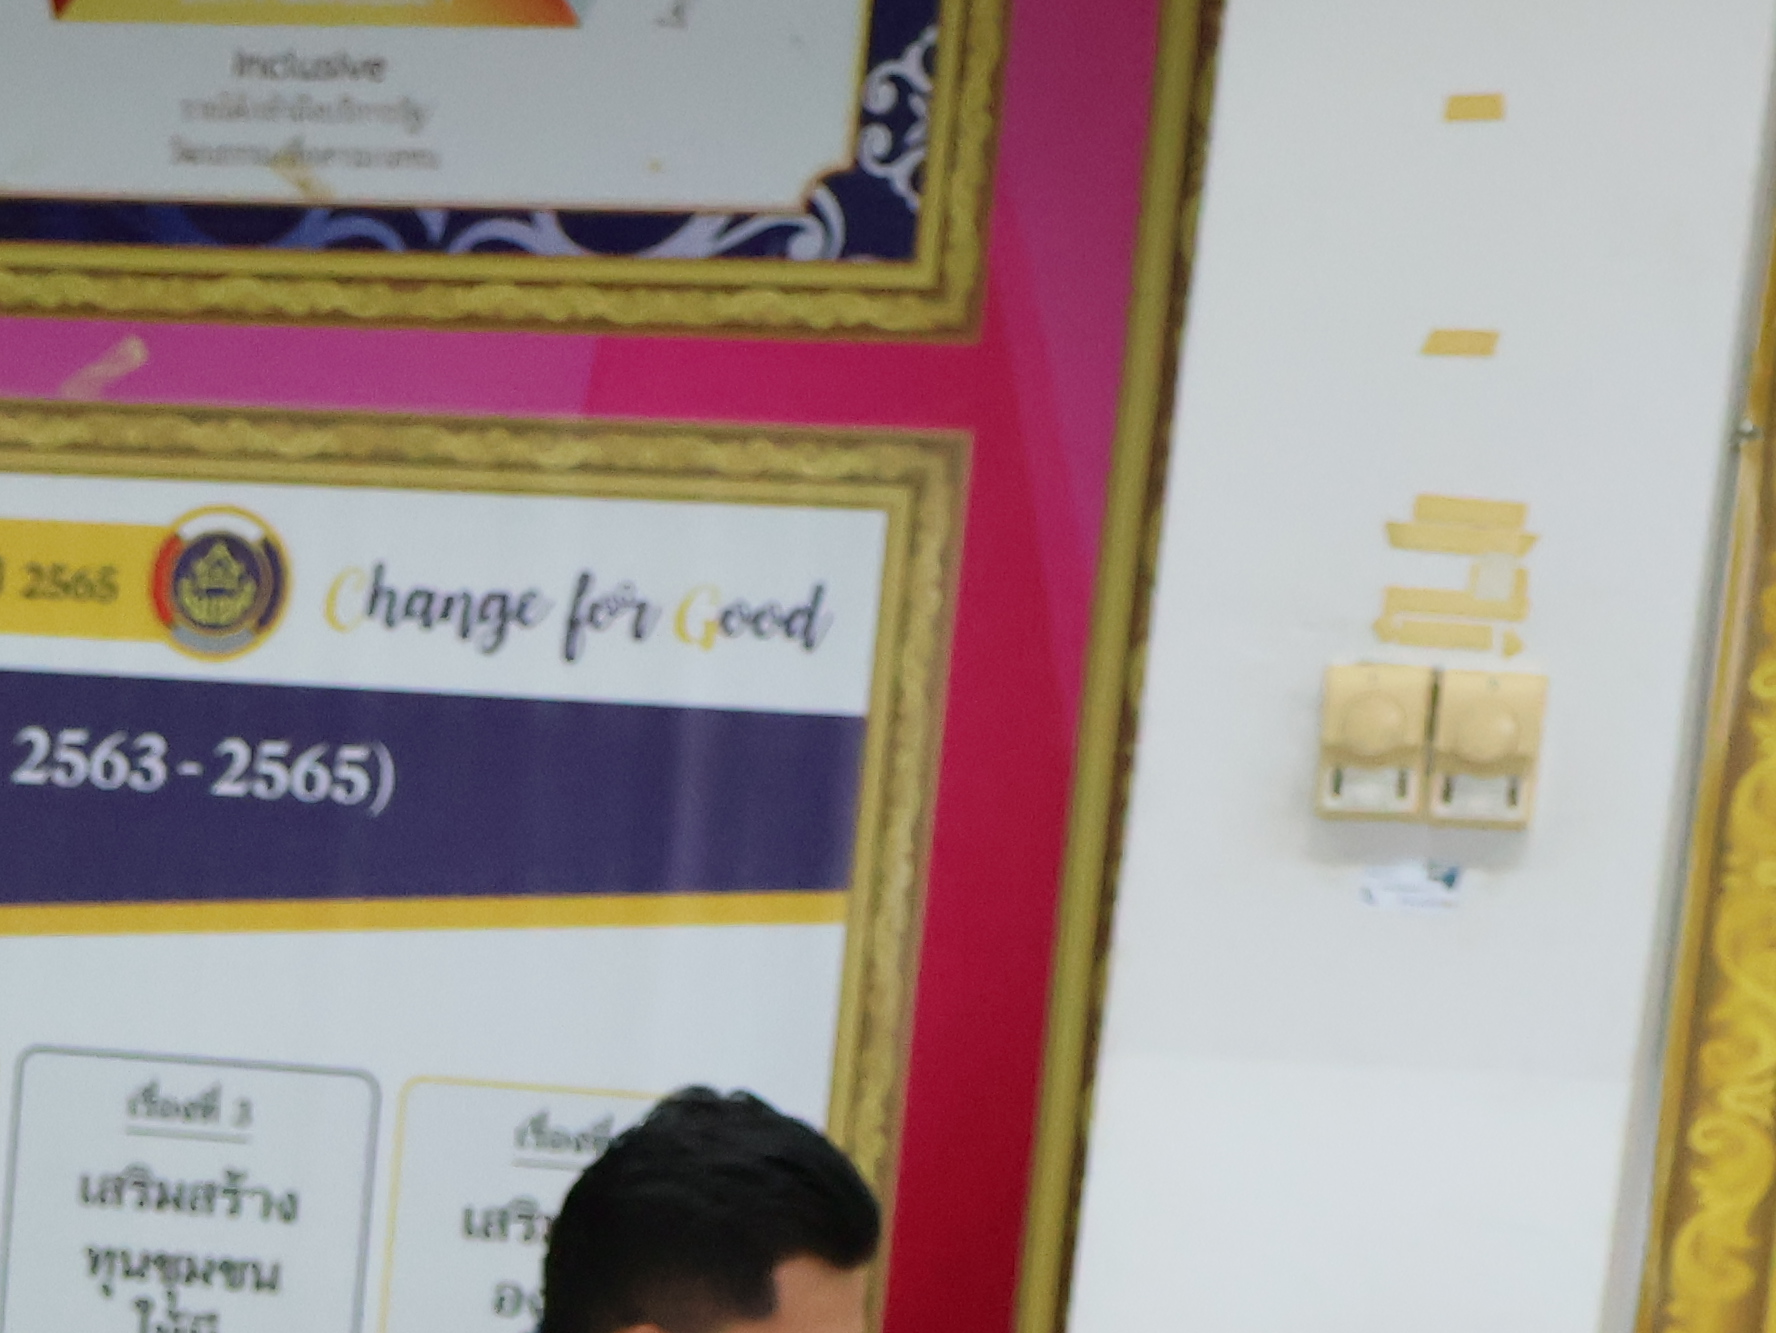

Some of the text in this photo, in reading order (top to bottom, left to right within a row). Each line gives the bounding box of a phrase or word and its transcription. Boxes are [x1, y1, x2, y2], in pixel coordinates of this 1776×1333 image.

[232, 50, 388, 82] Inclusive
[20, 561, 118, 602] 2565
[324, 562, 826, 662] Change for Good
[79, 1163, 299, 1225] เสริมสร้าง
[85, 1246, 280, 1302] ทุนชุมชน
